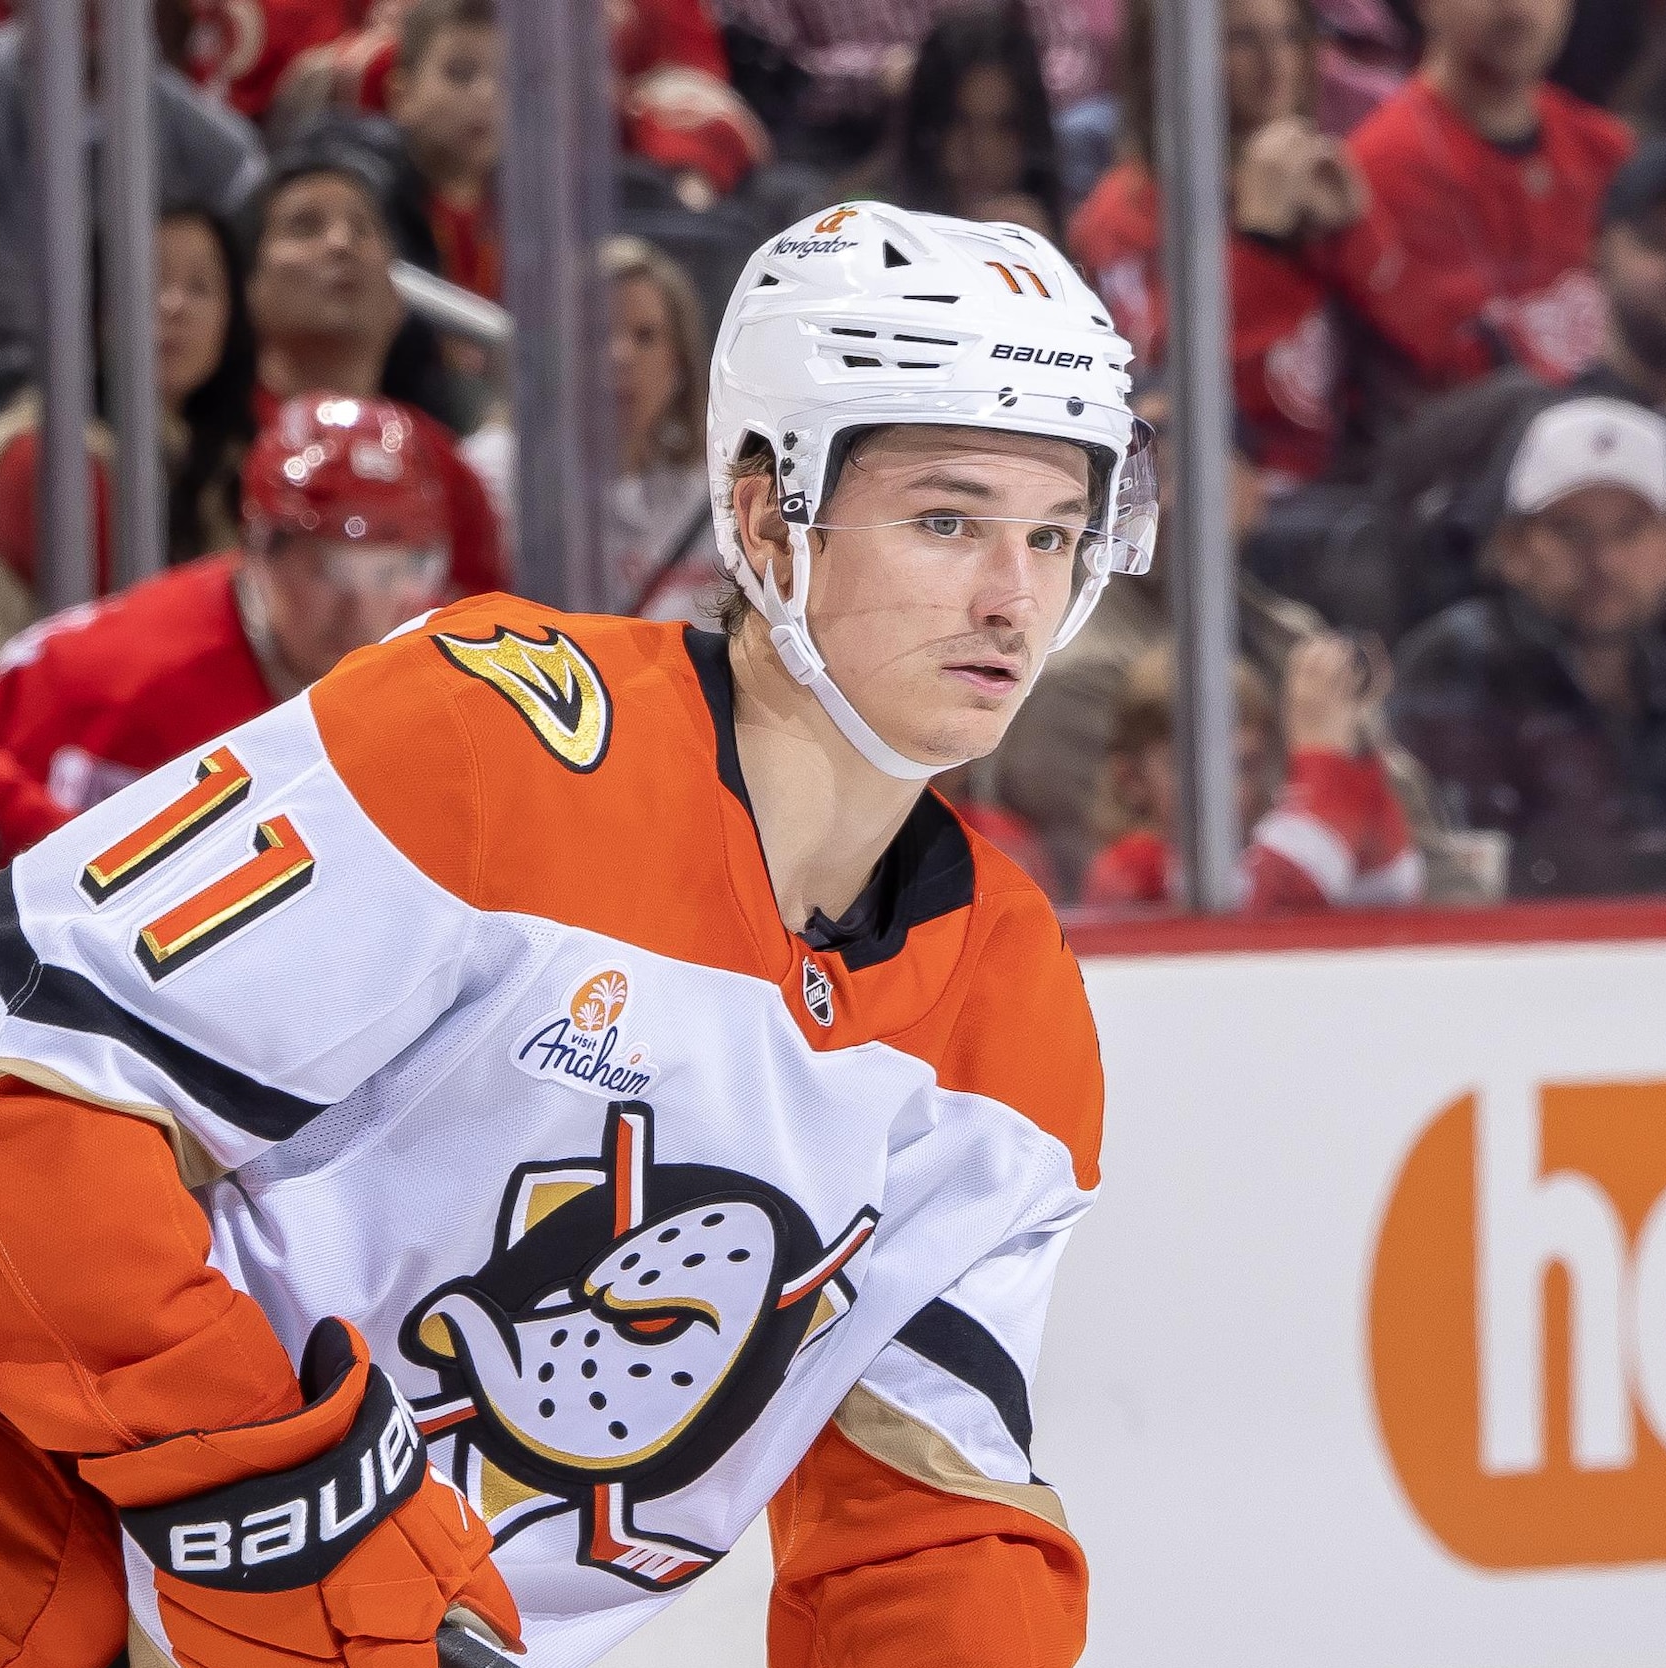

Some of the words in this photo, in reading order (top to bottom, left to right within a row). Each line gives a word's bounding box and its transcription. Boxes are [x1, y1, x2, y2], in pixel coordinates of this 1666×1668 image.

[767, 236, 859, 259] Navigator
[984, 261, 1052, 299] 11
[81, 745, 316, 983] 11
[518, 1018, 651, 1096] Anaheim
[571, 1033, 598, 1051] visit
